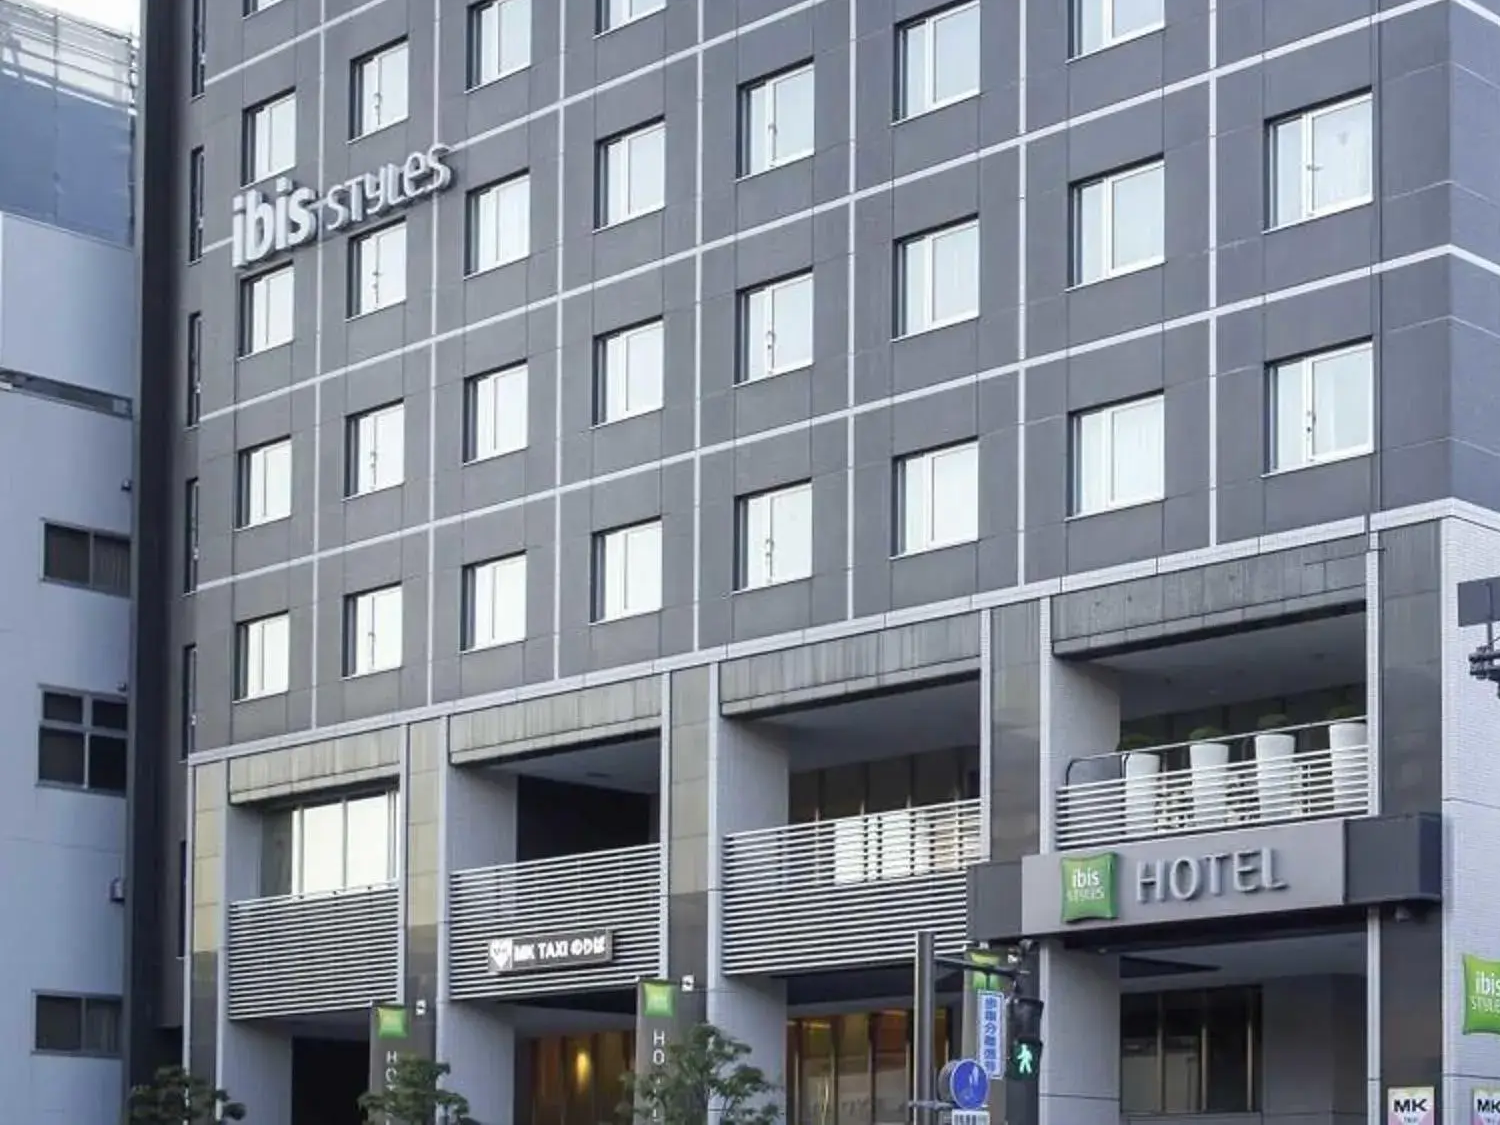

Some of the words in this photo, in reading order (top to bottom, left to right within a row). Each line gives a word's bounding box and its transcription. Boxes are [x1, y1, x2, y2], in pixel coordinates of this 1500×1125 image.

[232, 177, 317, 267] ibis
[1071, 868, 1101, 889] ibis
[1136, 847, 1291, 903] HOTEL
[537, 940, 569, 960] TAXI
[1393, 1098, 1427, 1114] MK
